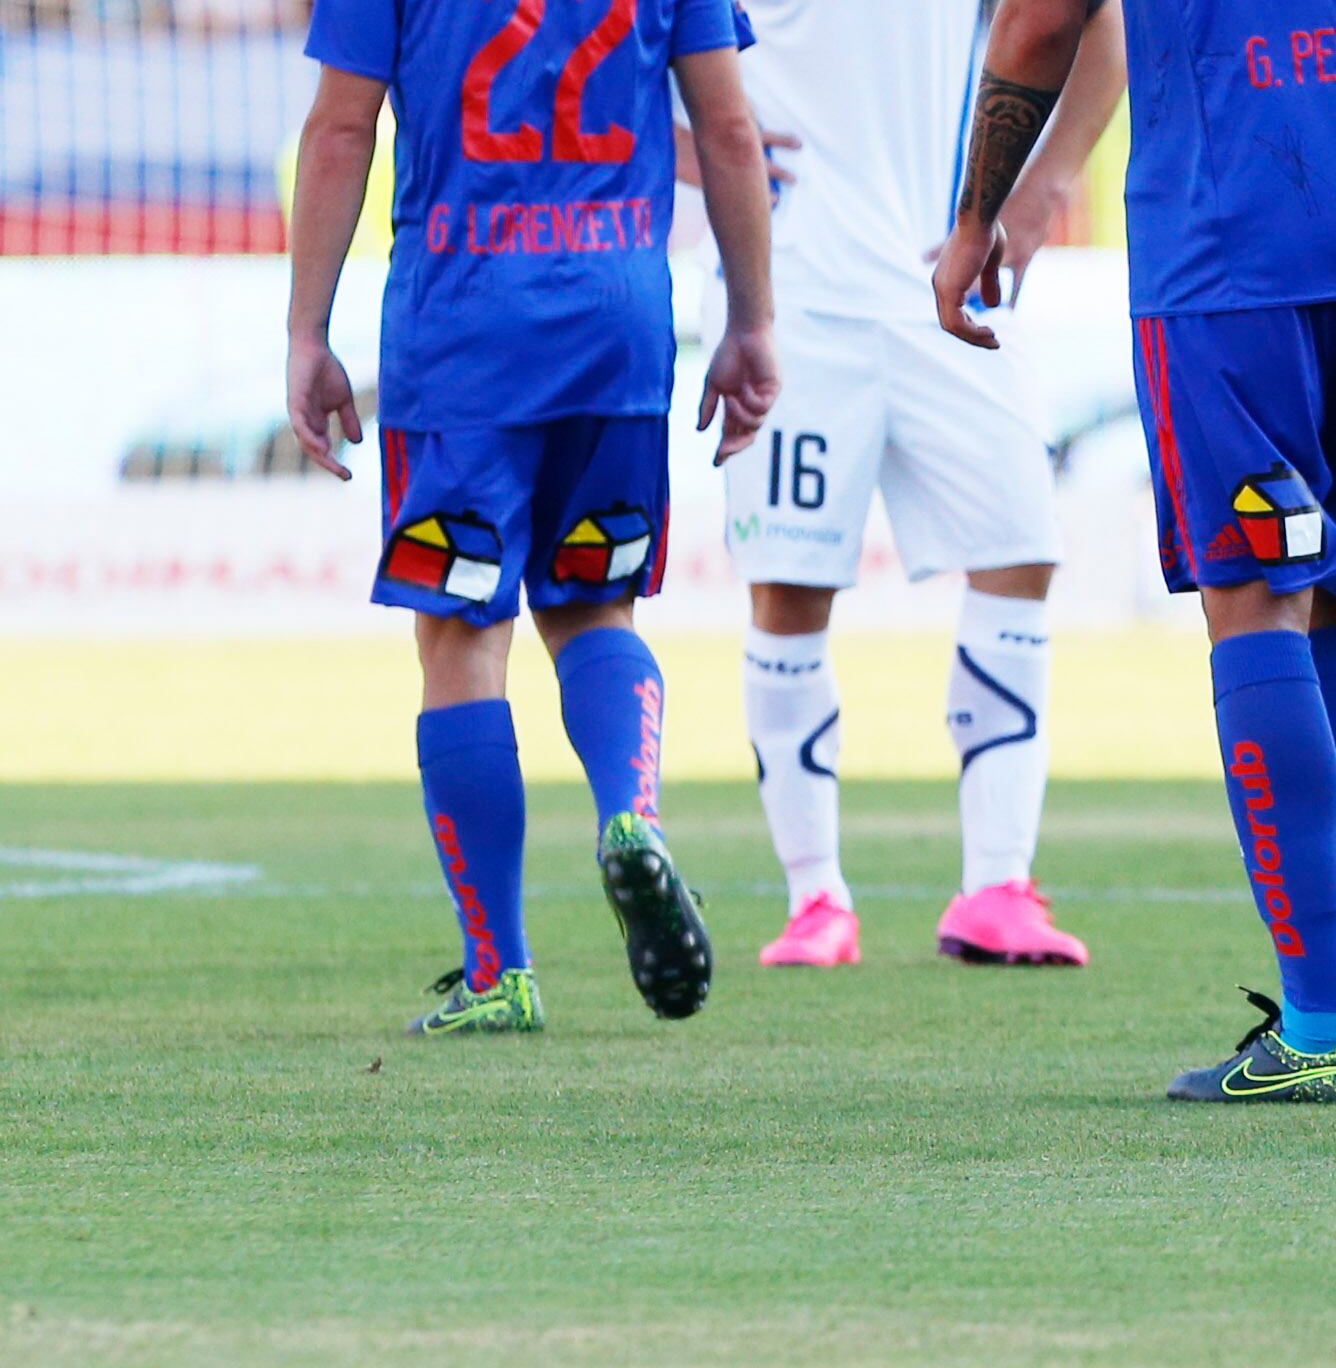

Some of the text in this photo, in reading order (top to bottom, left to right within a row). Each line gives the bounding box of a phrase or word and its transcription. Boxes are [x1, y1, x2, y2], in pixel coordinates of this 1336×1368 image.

[1246, 35, 1283, 89] G.
[427, 203, 456, 255] G.
[769, 430, 828, 510] 16
[1231, 740, 1306, 957] Dolorub
